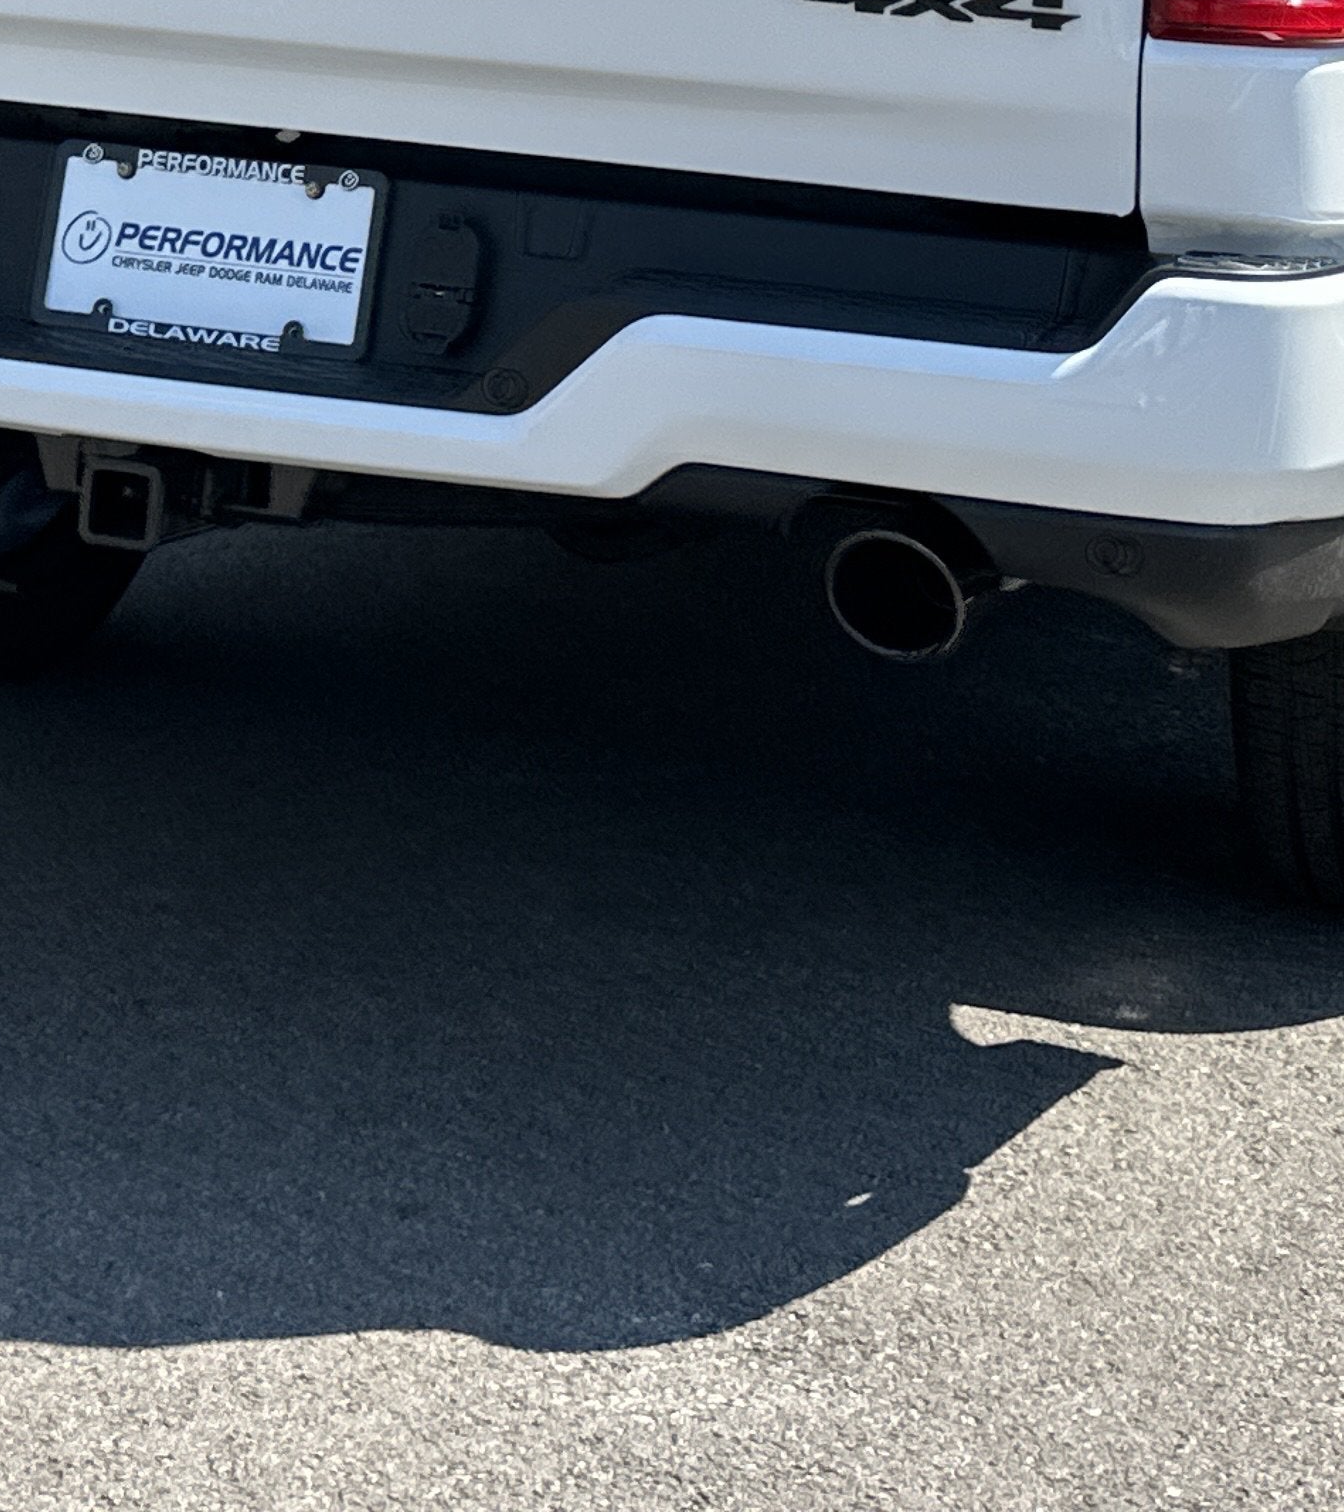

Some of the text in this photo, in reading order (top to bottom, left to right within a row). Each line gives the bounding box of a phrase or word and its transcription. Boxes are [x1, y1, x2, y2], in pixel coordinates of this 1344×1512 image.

[138, 149, 305, 183] PERFORMANCE
[115, 222, 363, 272] PERFORMANCE
[112, 255, 353, 294] CHRYSLER JEEP DODGE RAM DELAWARE
[108, 319, 280, 351] DELAWARE
